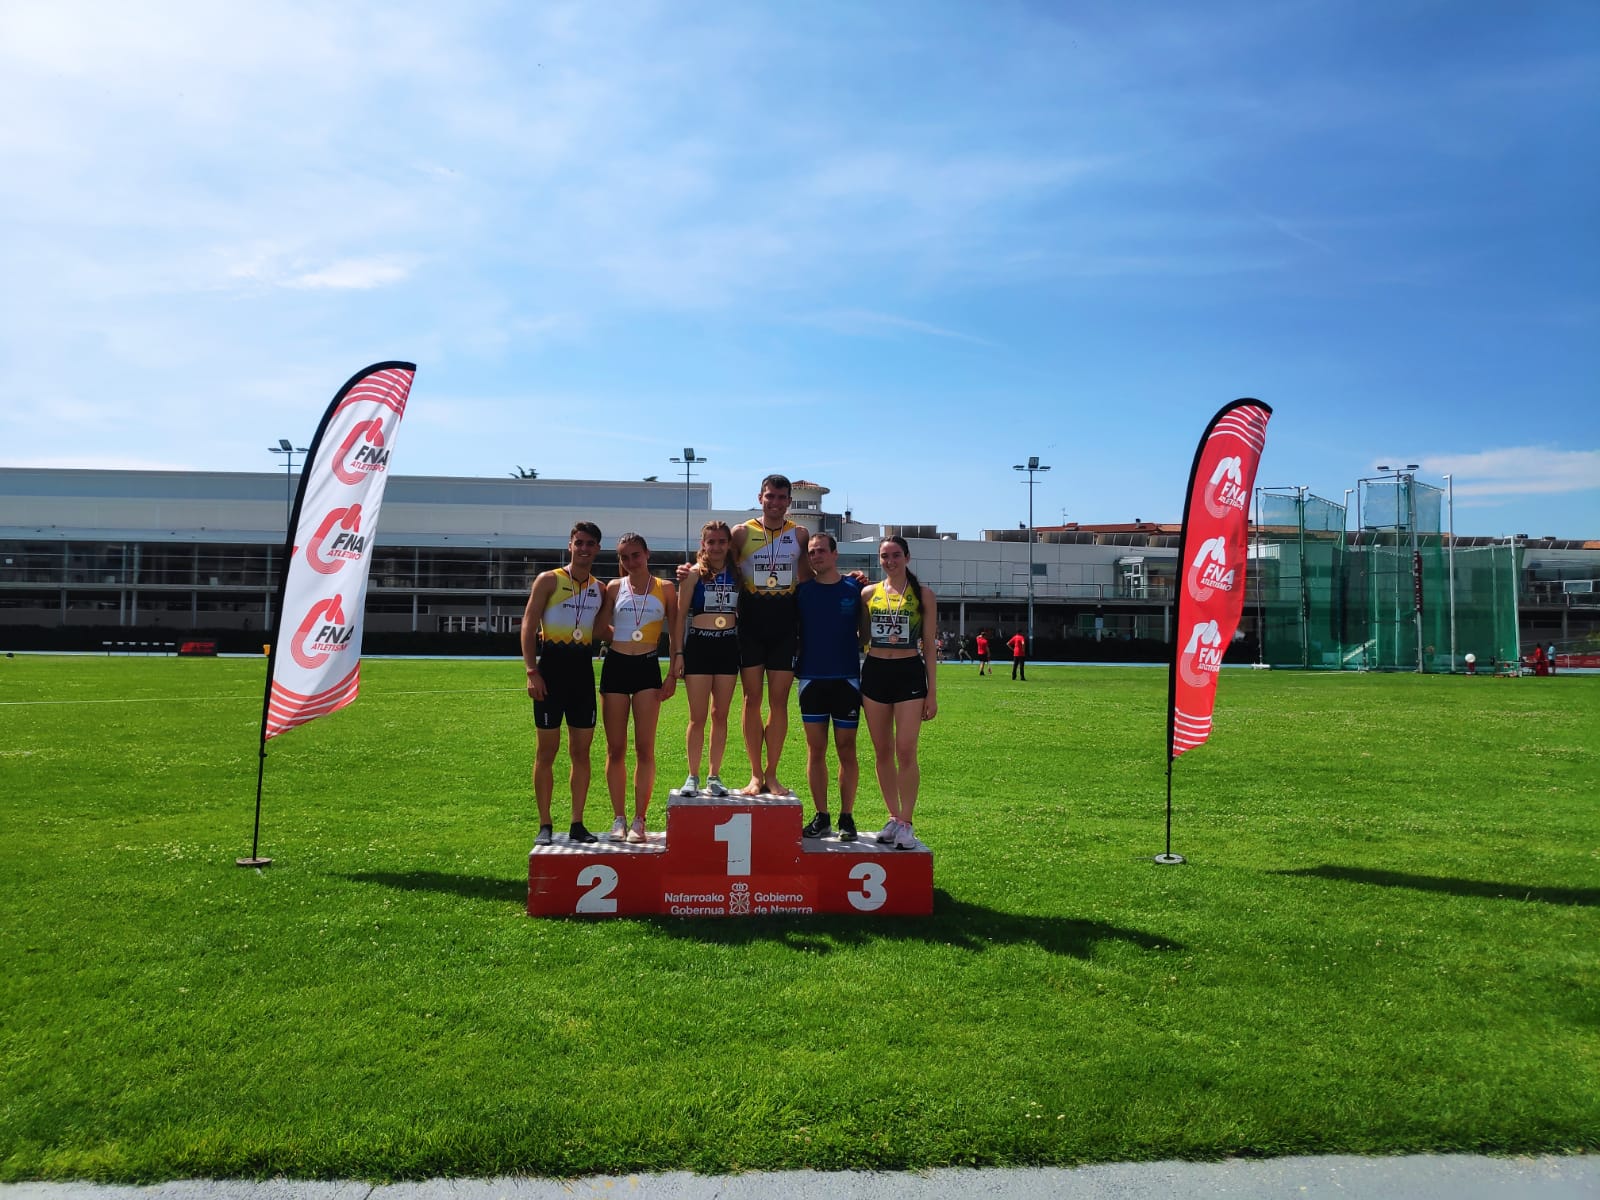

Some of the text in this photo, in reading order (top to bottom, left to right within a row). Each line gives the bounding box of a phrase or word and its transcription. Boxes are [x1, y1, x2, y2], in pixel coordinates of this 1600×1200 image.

[355, 445, 390, 466] FNA
[1221, 481, 1247, 506] FNA
[331, 533, 365, 553] FNA
[1203, 563, 1235, 585] FNA
[315, 625, 355, 644] FNA
[698, 630, 722, 638] NIKE
[876, 624, 903, 635] 373
[311, 643, 348, 652] ATLETISM
[1199, 647, 1222, 665] FN
[714, 813, 752, 876] 1
[575, 864, 619, 913] 2
[847, 862, 888, 911] 3
[664, 892, 725, 903] Nafarroako
[754, 892, 803, 903] Gobierno
[670, 905, 725, 916] Gobernua
[754, 905, 813, 915] de Navarra
